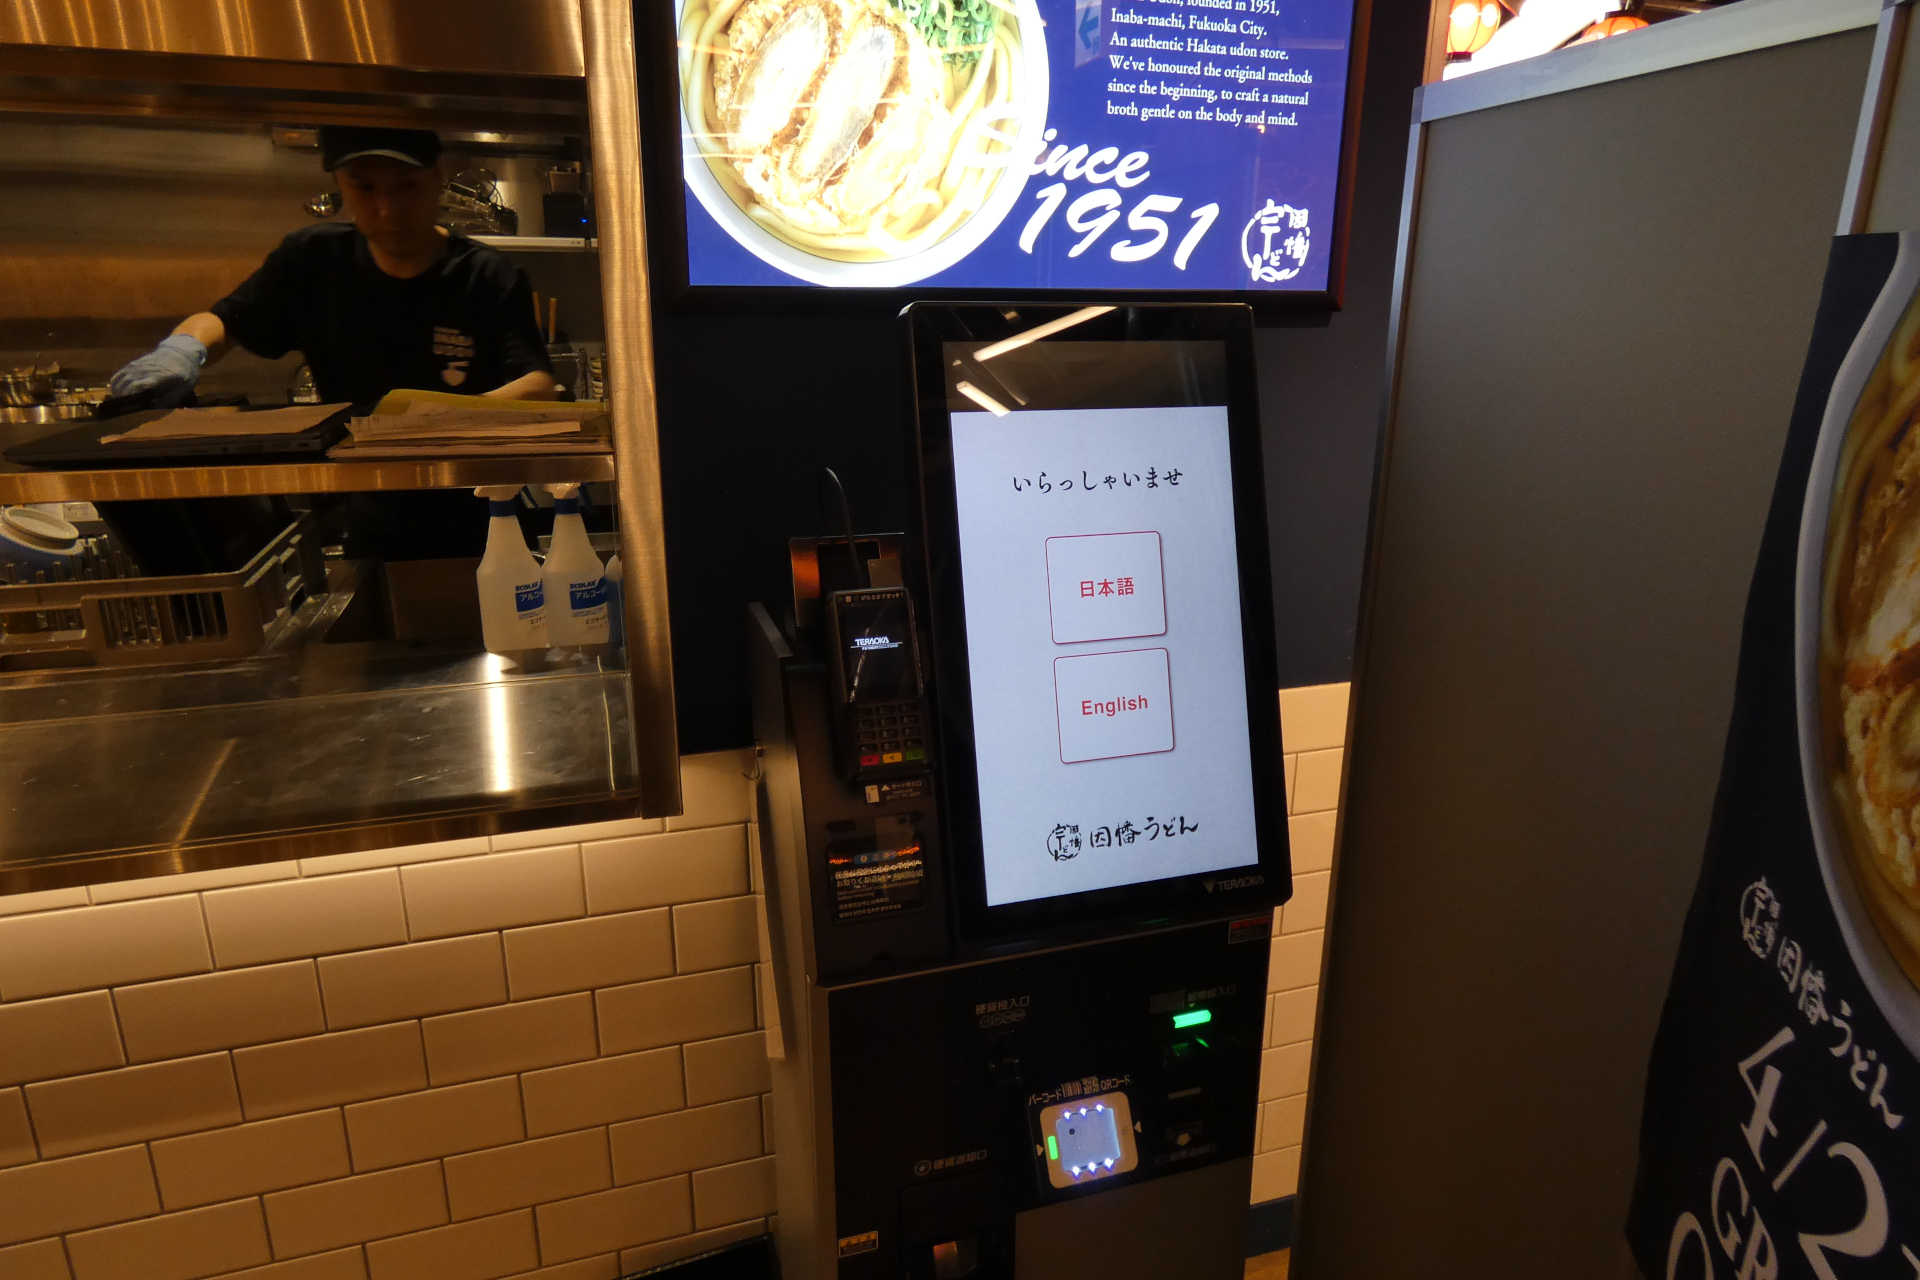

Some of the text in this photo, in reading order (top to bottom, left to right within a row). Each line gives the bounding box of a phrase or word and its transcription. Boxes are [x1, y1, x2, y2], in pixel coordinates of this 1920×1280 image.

[1235, 0, 1246, 10] in
[1250, 0, 1280, 16] 1951,
[1111, 7, 1268, 39] Inaba-machi, Fukuoka City.
[1109, 31, 1289, 60] An authentic Hakata udon store.
[1109, 54, 1313, 84] We've honoured the original methods
[1107, 78, 1309, 105] since the beginning, to craft a natural
[1107, 100, 1298, 127] broth gentle on the body and mind.
[1019, 182, 1220, 271] 1951
[1012, 466, 1183, 494] いらっしゃいませ
[1080, 577, 1134, 598] 日本語
[854, 636, 890, 646] TERAOKA
[1081, 694, 1149, 718] English
[1090, 816, 1200, 848] 因幡うどん
[1216, 874, 1264, 892] TERAOKA
[1777, 935, 1904, 1130] 因幡うどん
[1028, 1074, 1132, 1106] バーコード QRコード
